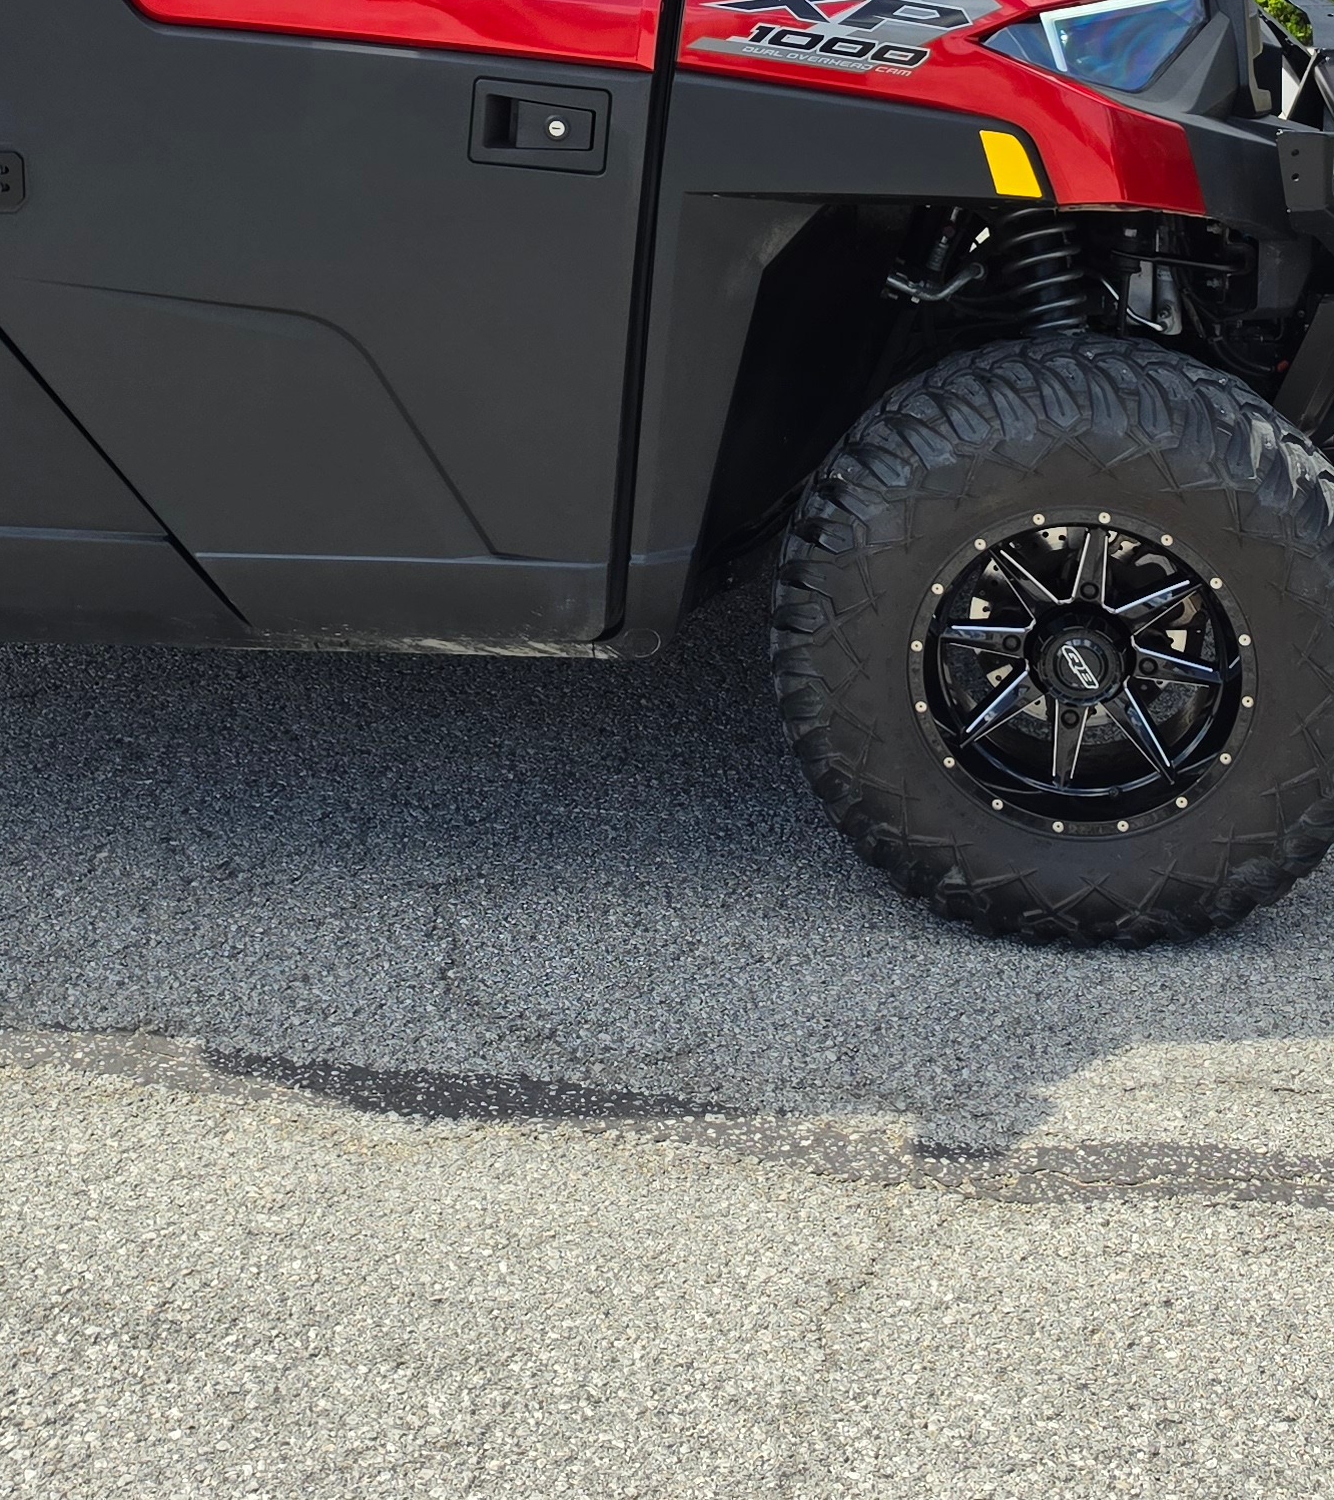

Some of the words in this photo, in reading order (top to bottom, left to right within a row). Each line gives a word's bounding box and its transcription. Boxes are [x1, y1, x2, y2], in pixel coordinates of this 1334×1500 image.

[742, 45, 784, 58] DUAL
[786, 52, 874, 71] OVERHEAD
[874, 65, 914, 77] CAM
[745, 22, 931, 69] 1000
